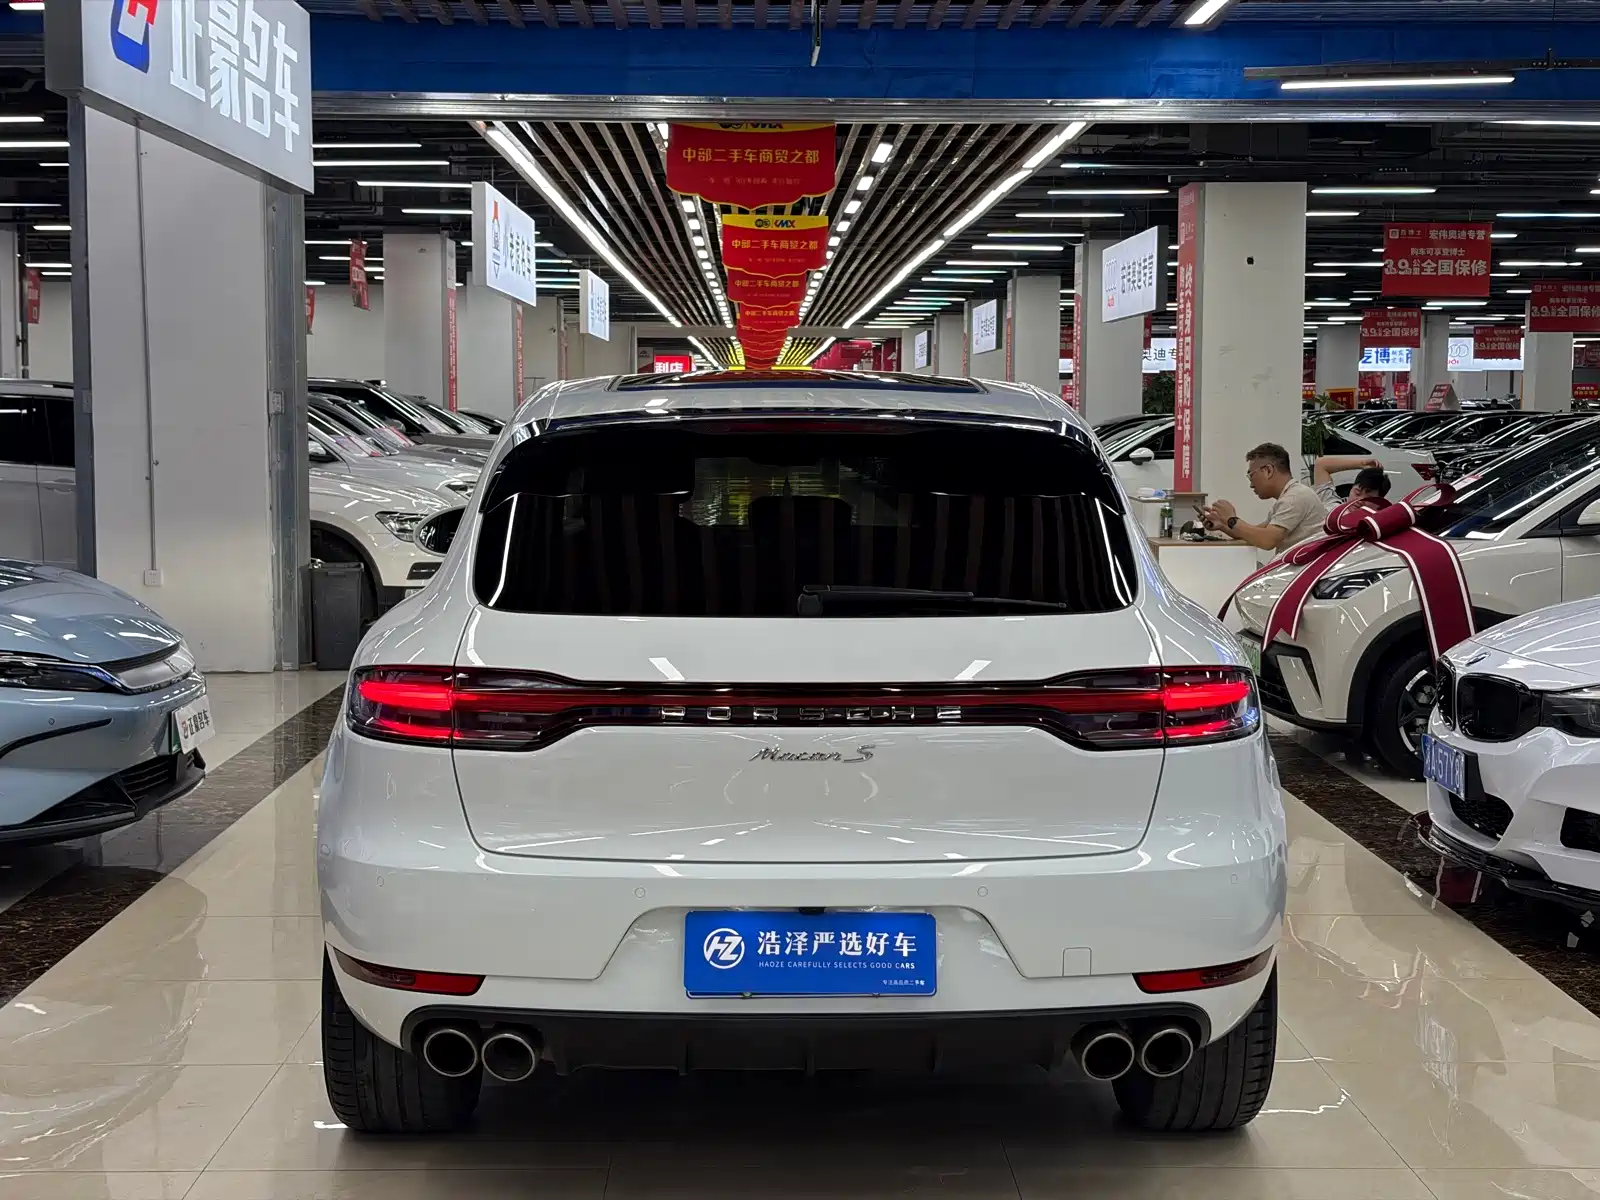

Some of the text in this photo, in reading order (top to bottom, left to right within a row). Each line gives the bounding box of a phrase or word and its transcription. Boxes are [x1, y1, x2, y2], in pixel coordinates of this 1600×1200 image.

[682, 147, 820, 165] 中部二手车商贸之都
[1429, 229, 1486, 240] 宏伟奥迪专营
[731, 239, 819, 250] 中部二手车商贸之都
[660, 706, 963, 721] PORSCHE
[749, 744, 876, 763] Macan S
[757, 930, 918, 957] 浩泽严选好车
[787, 961, 831, 969] CAREFULLY
[833, 961, 868, 969] SELECTS
[895, 962, 915, 970] CARS
